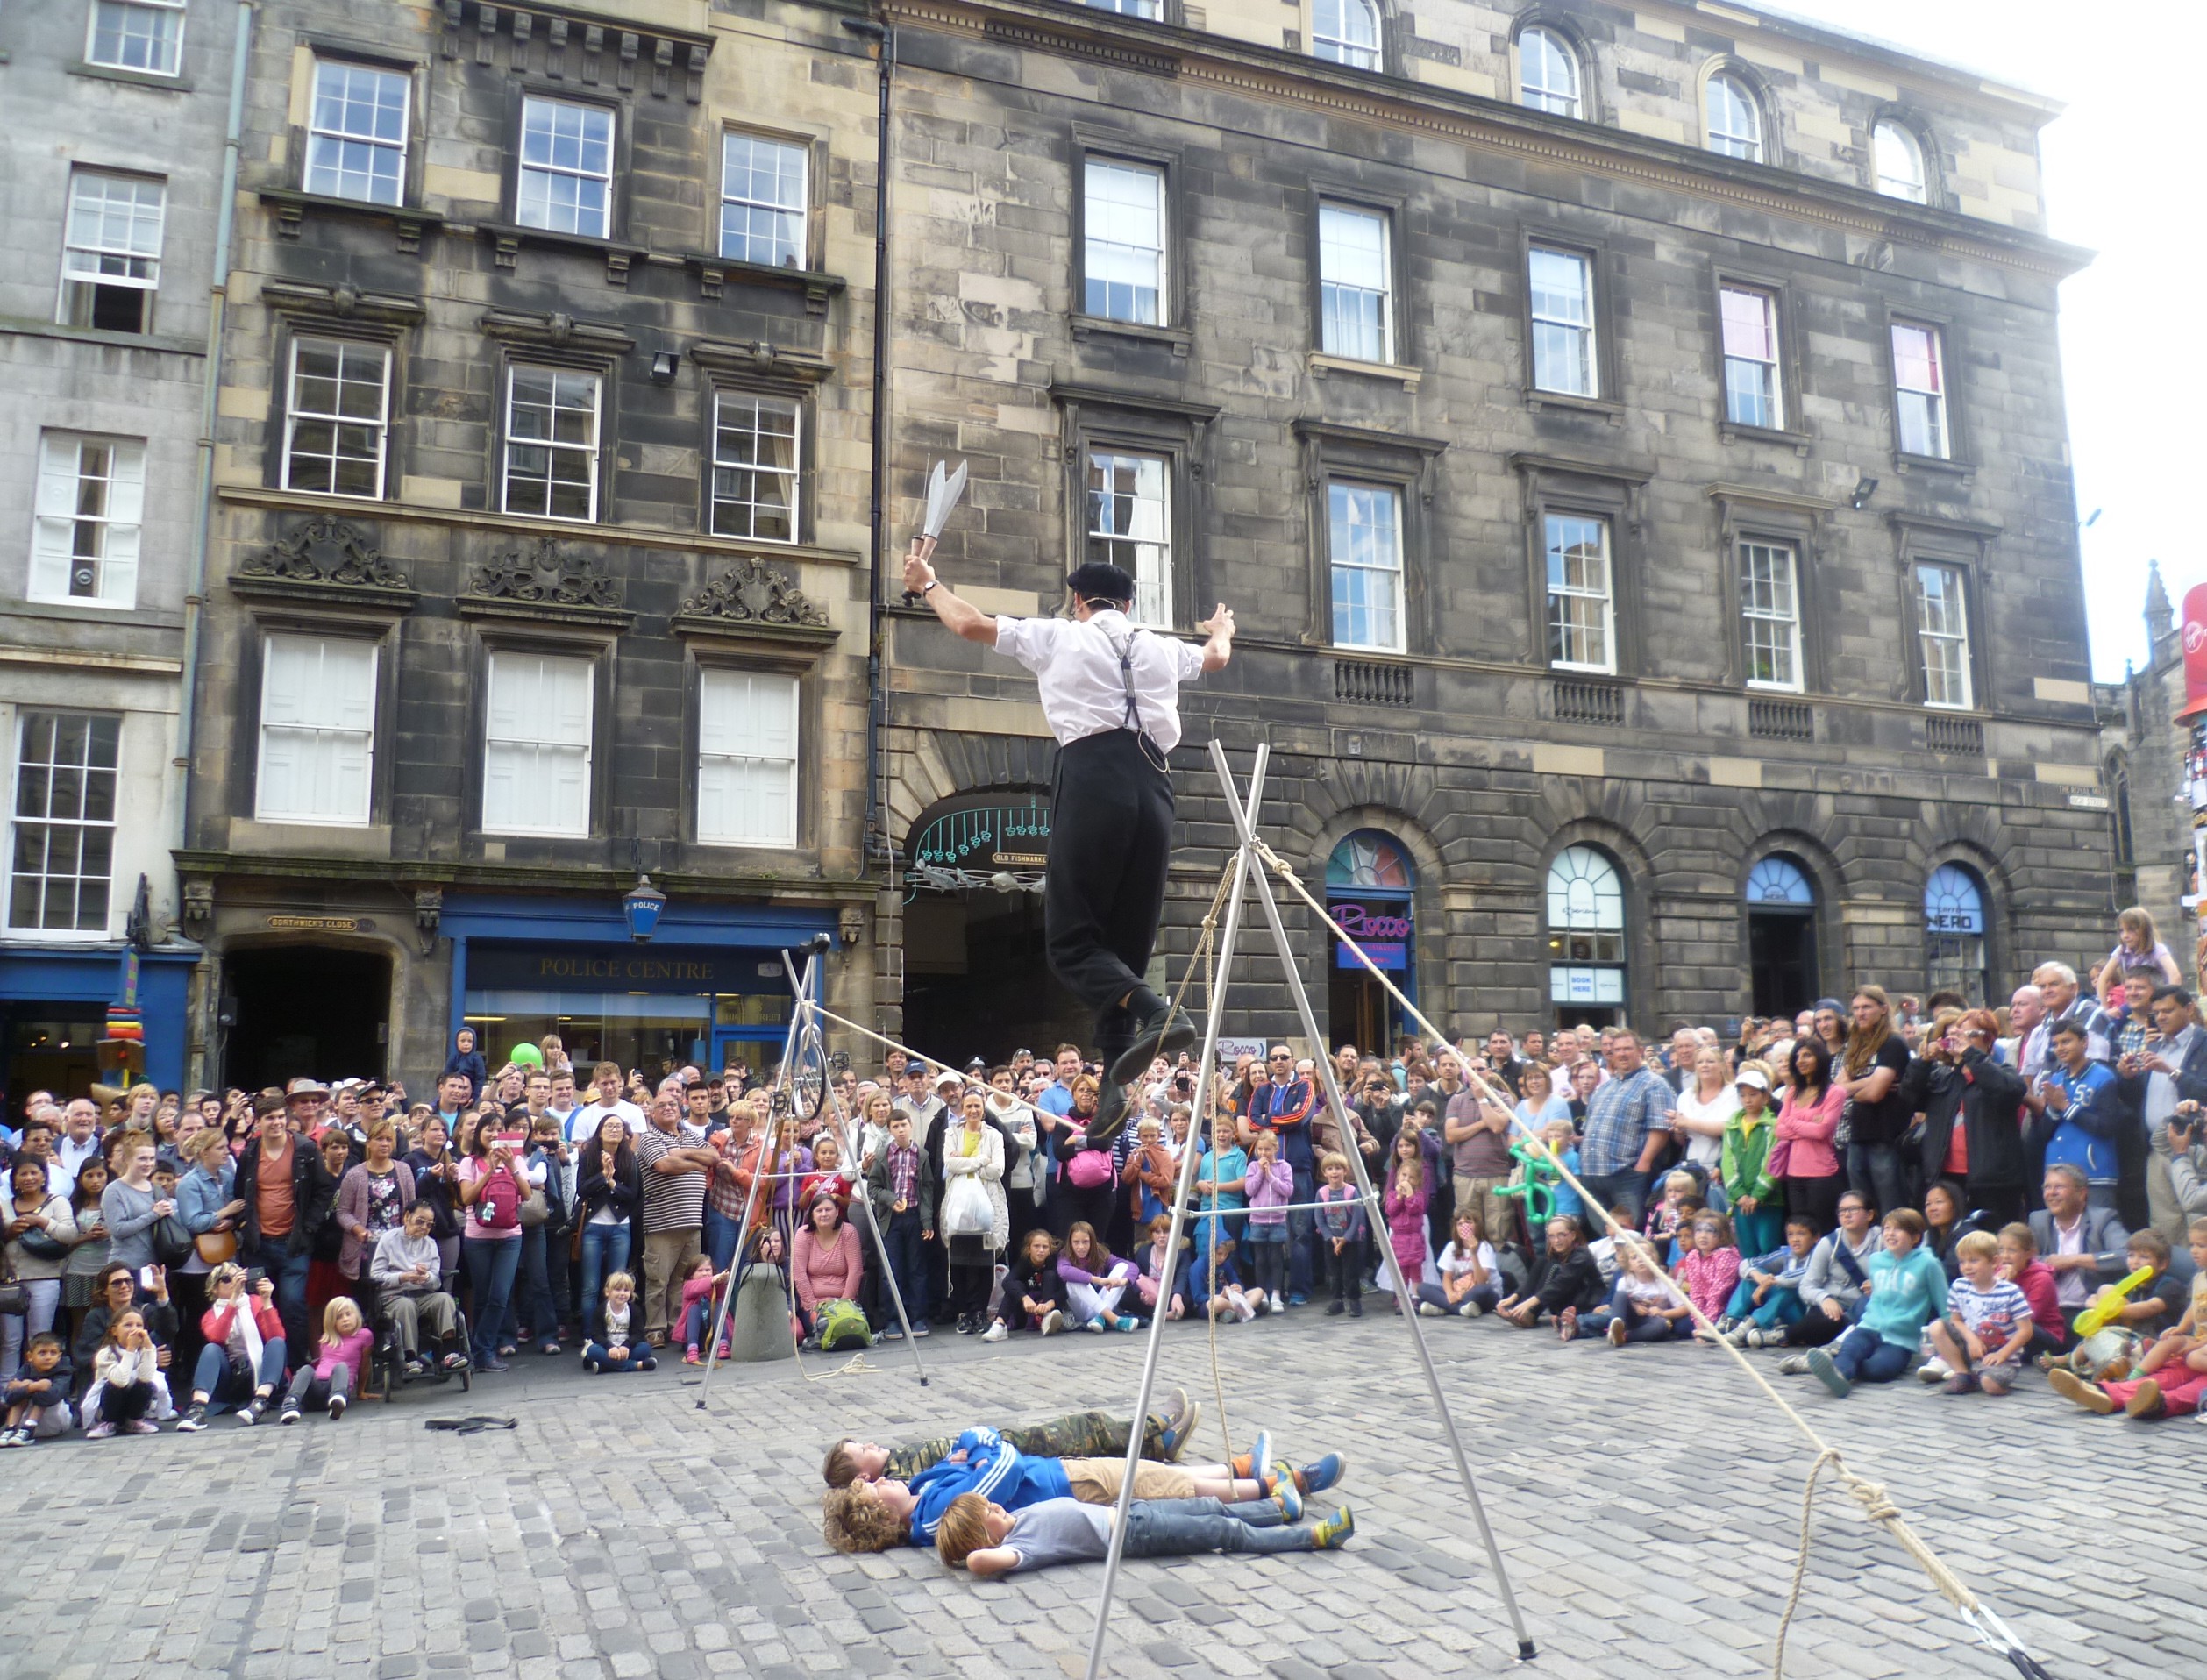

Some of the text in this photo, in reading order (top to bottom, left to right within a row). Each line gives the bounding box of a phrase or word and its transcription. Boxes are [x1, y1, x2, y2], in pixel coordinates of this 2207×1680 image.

[1011, 854, 1047, 863] FISHMARKE
[633, 901, 659, 911] POLICE
[326, 920, 352, 929] CLOSE
[1329, 904, 1410, 937] Rocco
[1927, 915, 1972, 929] NERO
[540, 958, 715, 979] POLICE CENTRE
[1217, 1040, 1257, 1055] Rocco
